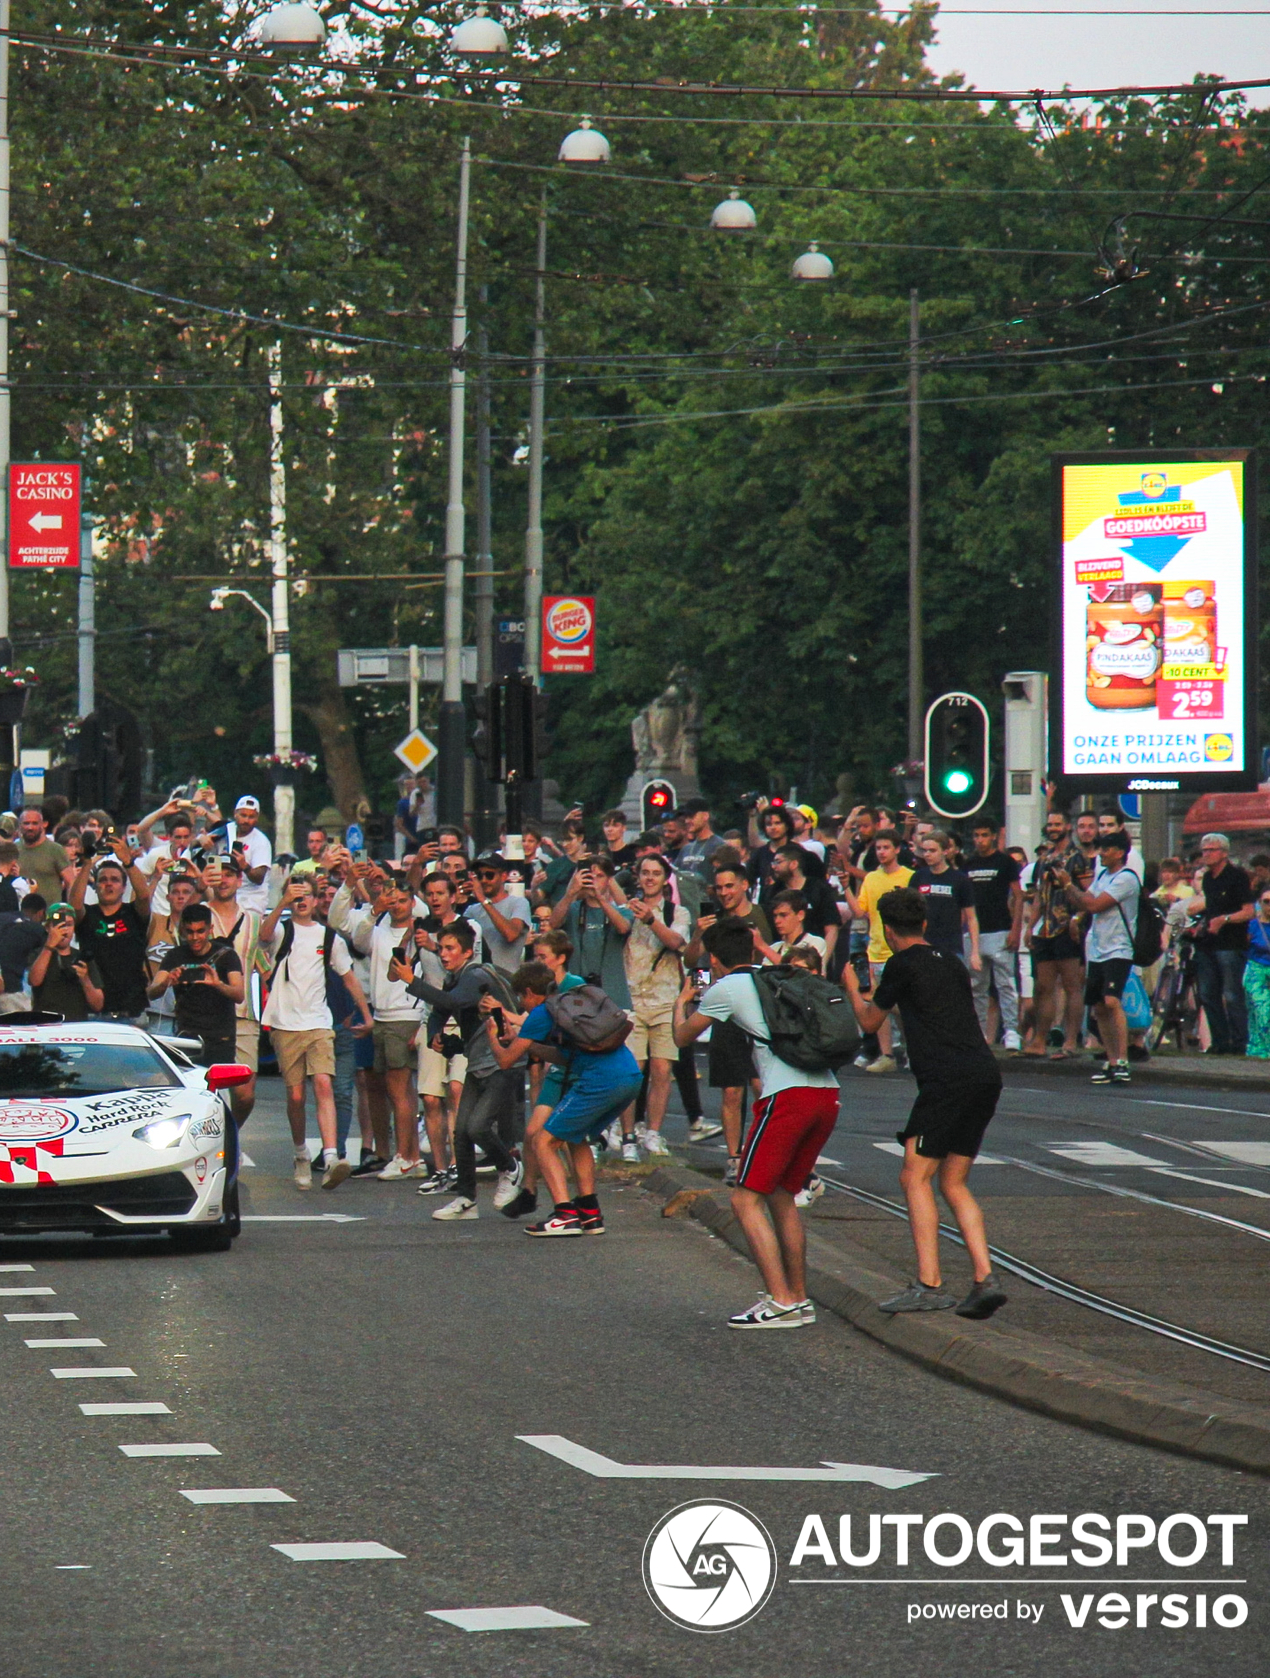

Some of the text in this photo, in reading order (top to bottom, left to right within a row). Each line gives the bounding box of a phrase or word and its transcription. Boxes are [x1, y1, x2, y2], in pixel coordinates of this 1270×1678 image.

[17, 472, 72, 485] JACK'S
[17, 487, 73, 500] CASINO
[49, 555, 67, 563] CITY
[553, 615, 586, 633] KING
[1183, 668, 1209, 677] CENT
[948, 697, 968, 706] 712
[1074, 734, 1197, 747] ONZE PRIJZEN
[1074, 751, 1201, 765] GAAN OMLAAG
[83, 1091, 171, 1112] Kappa
[86, 1100, 172, 1123] Hard Rock
[79, 1110, 163, 1134] CARRERA
